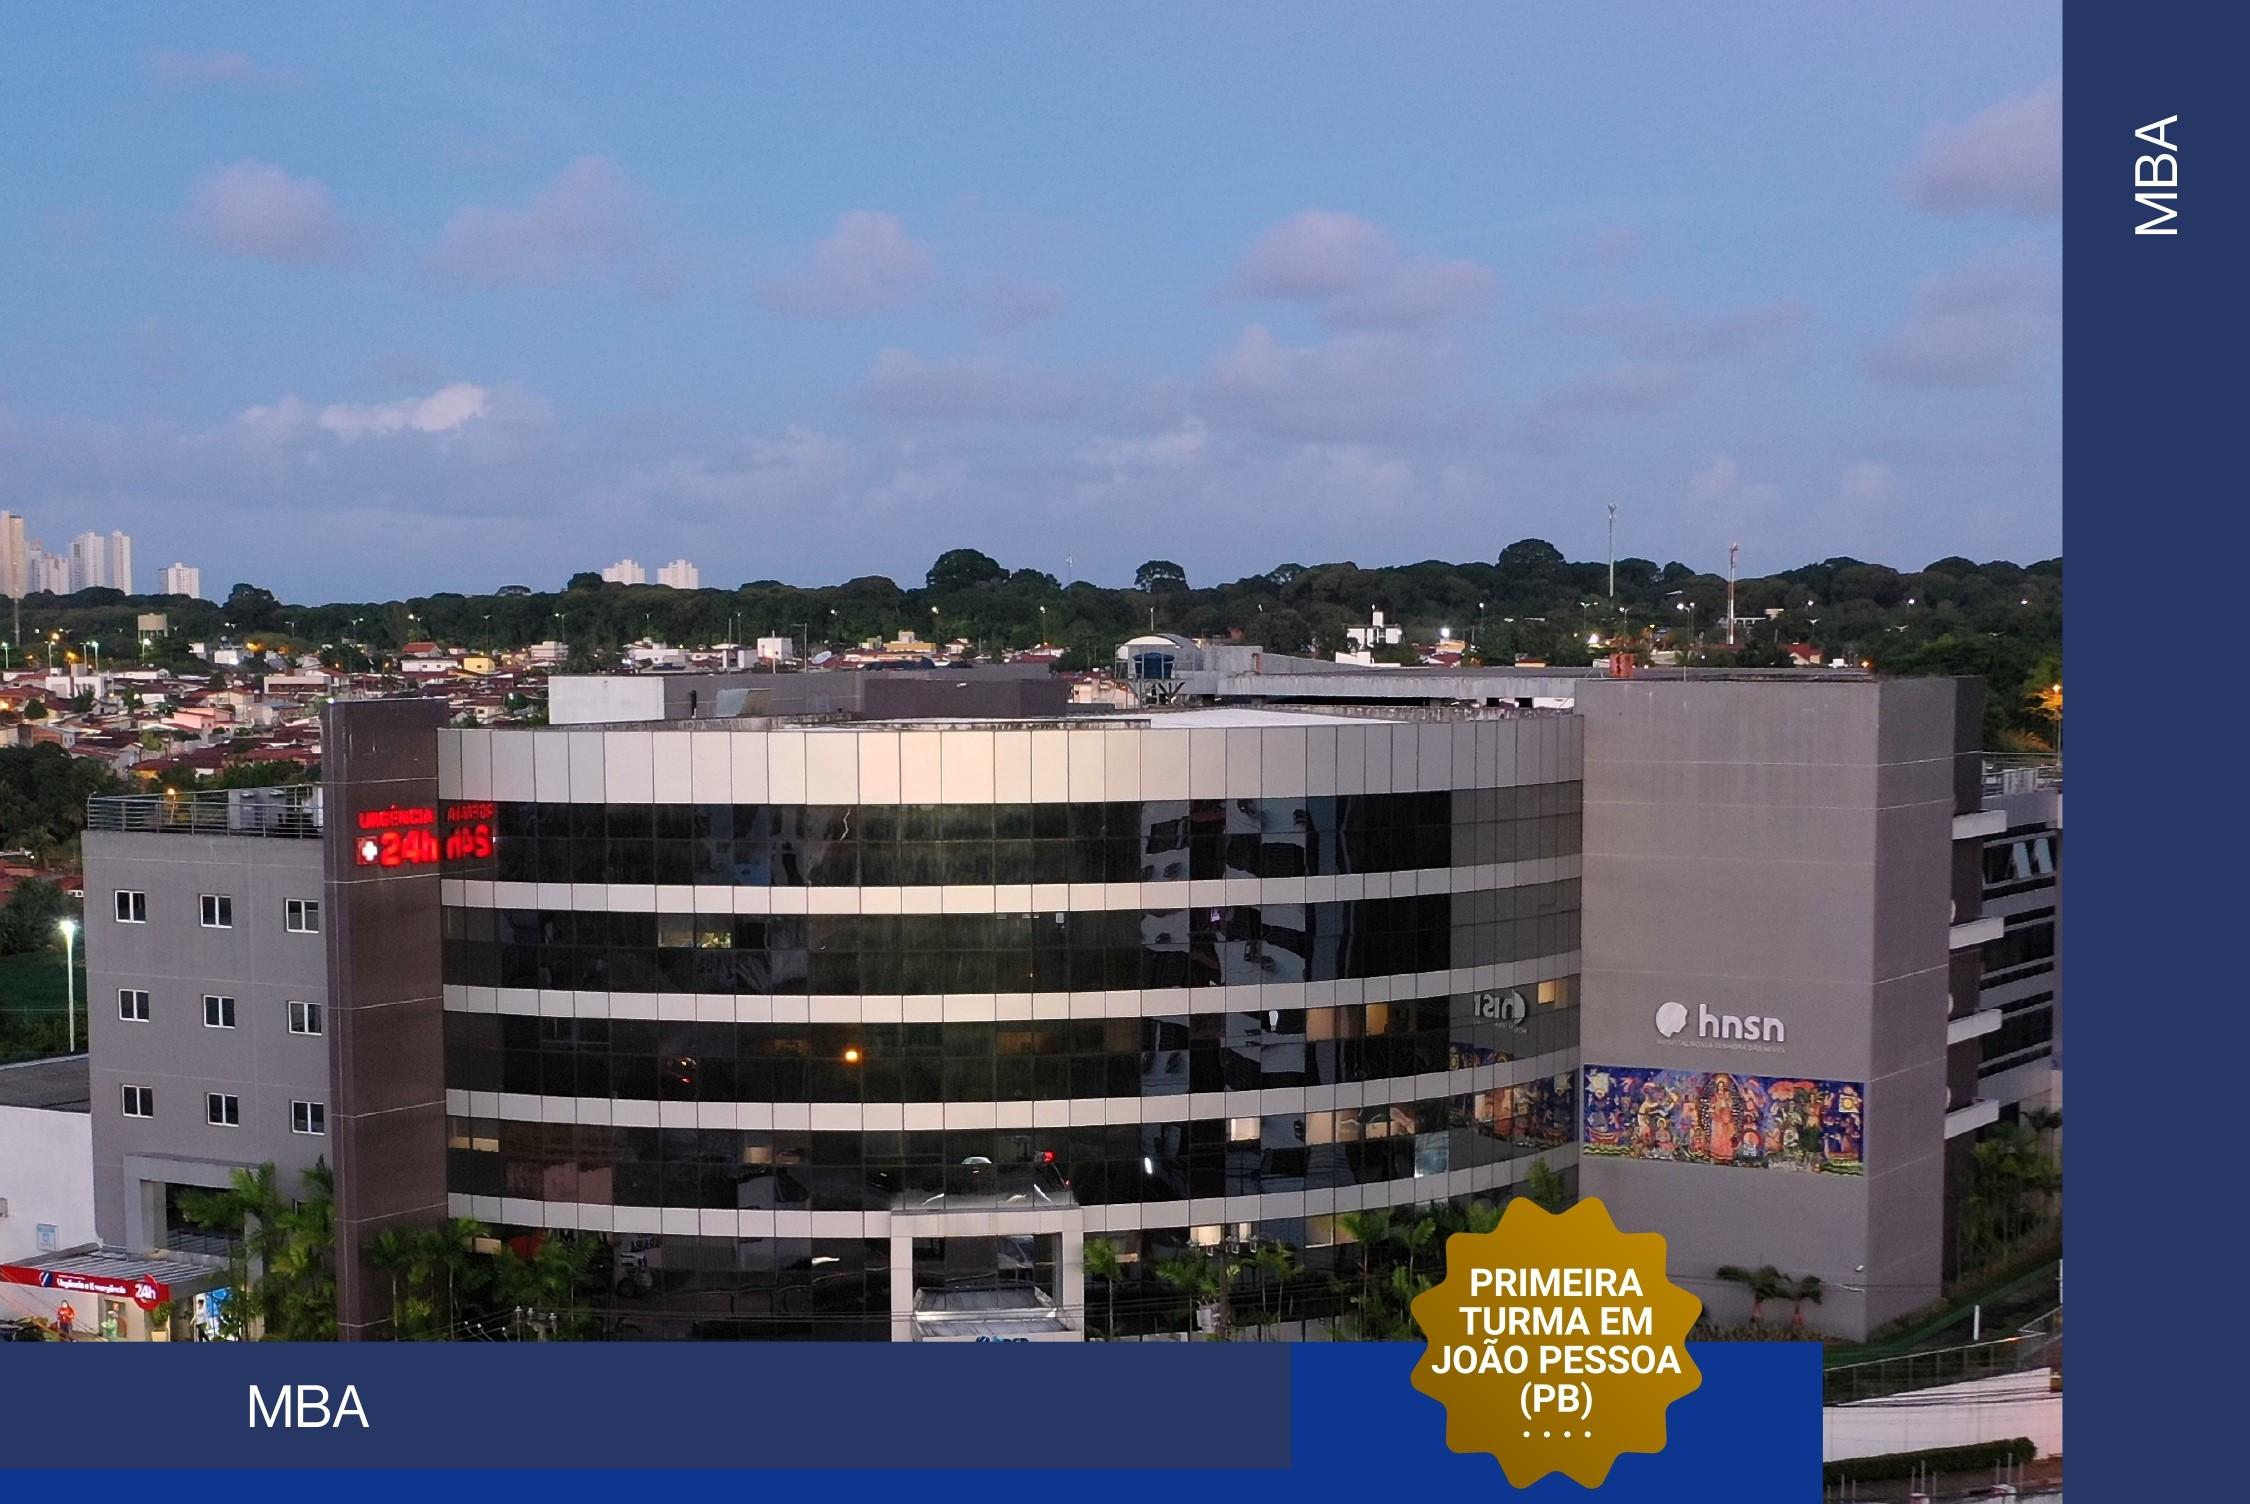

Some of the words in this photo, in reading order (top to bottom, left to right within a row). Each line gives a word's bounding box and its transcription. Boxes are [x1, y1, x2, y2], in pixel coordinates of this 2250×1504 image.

[380, 829, 439, 866] 24h
[1698, 1003, 1785, 1042] hnsn
[135, 1283, 156, 1299] 24h
